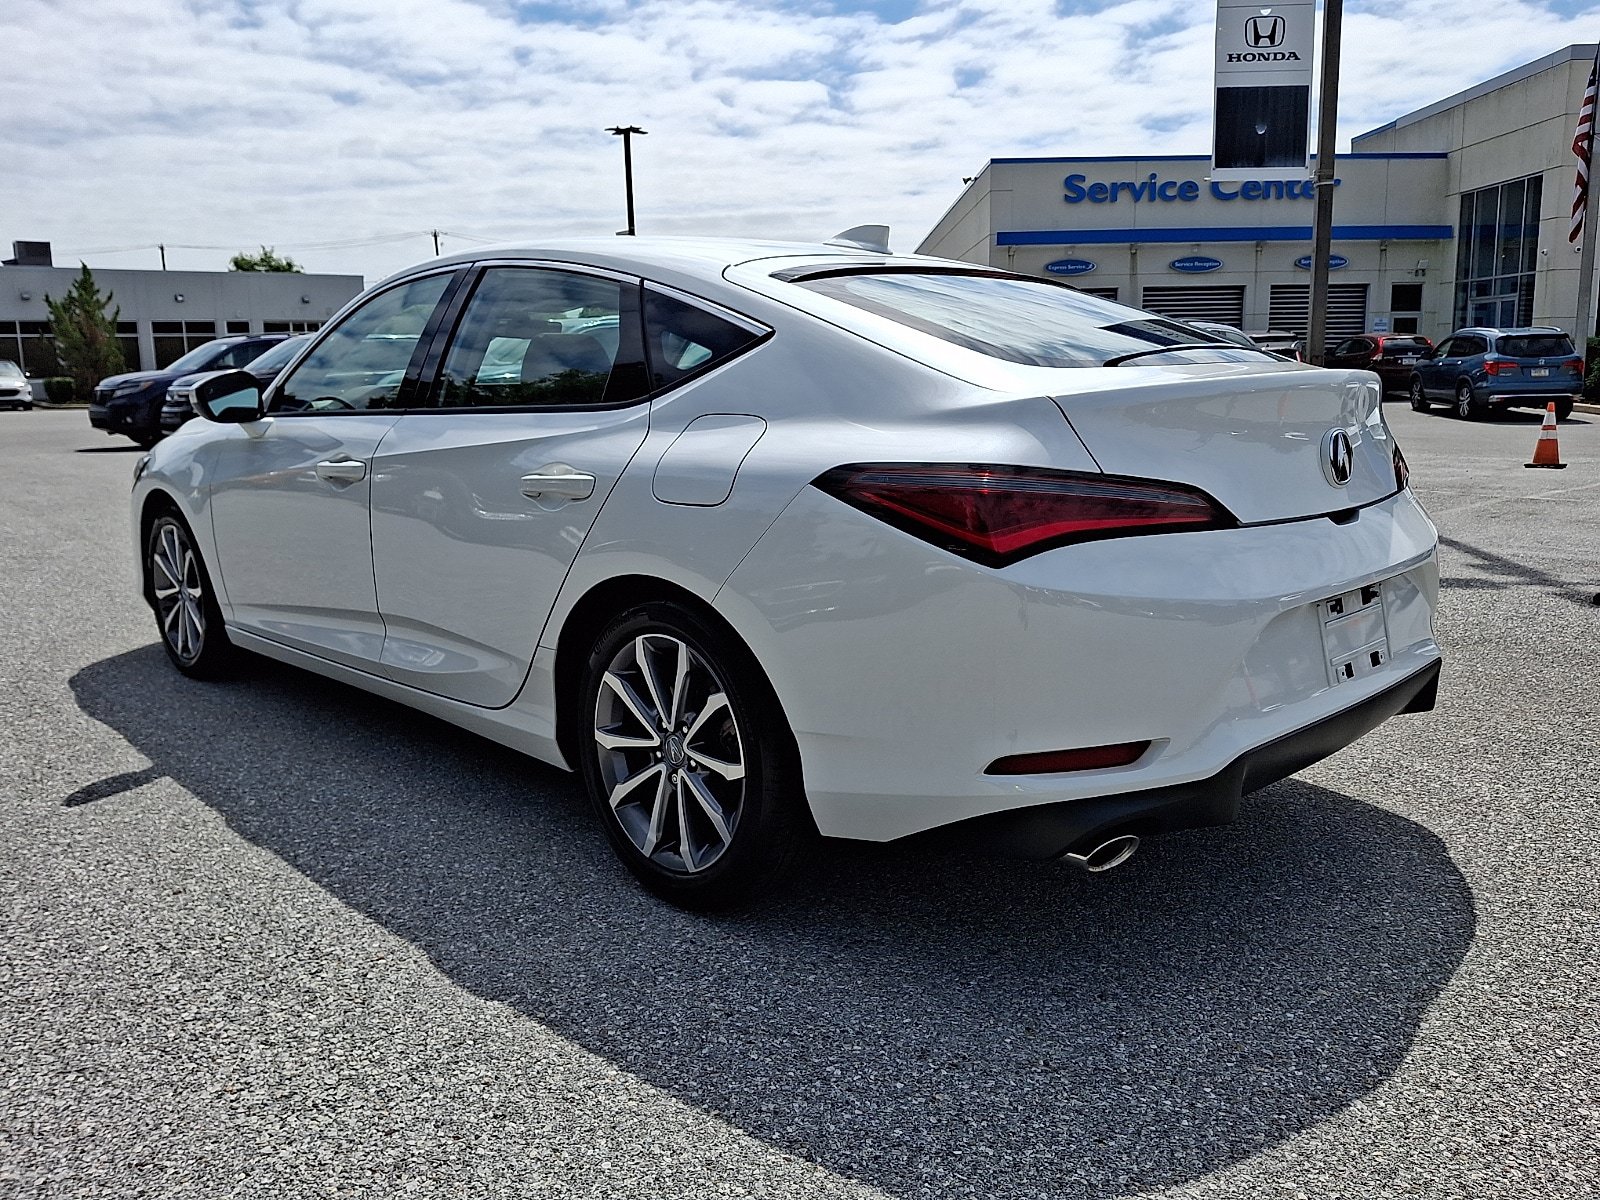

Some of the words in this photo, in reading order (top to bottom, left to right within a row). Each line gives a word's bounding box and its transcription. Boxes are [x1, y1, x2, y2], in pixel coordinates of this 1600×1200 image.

[1226, 51, 1301, 63] HONDA
[1063, 173, 1199, 204] Service
[1210, 179, 1342, 201] Cente
